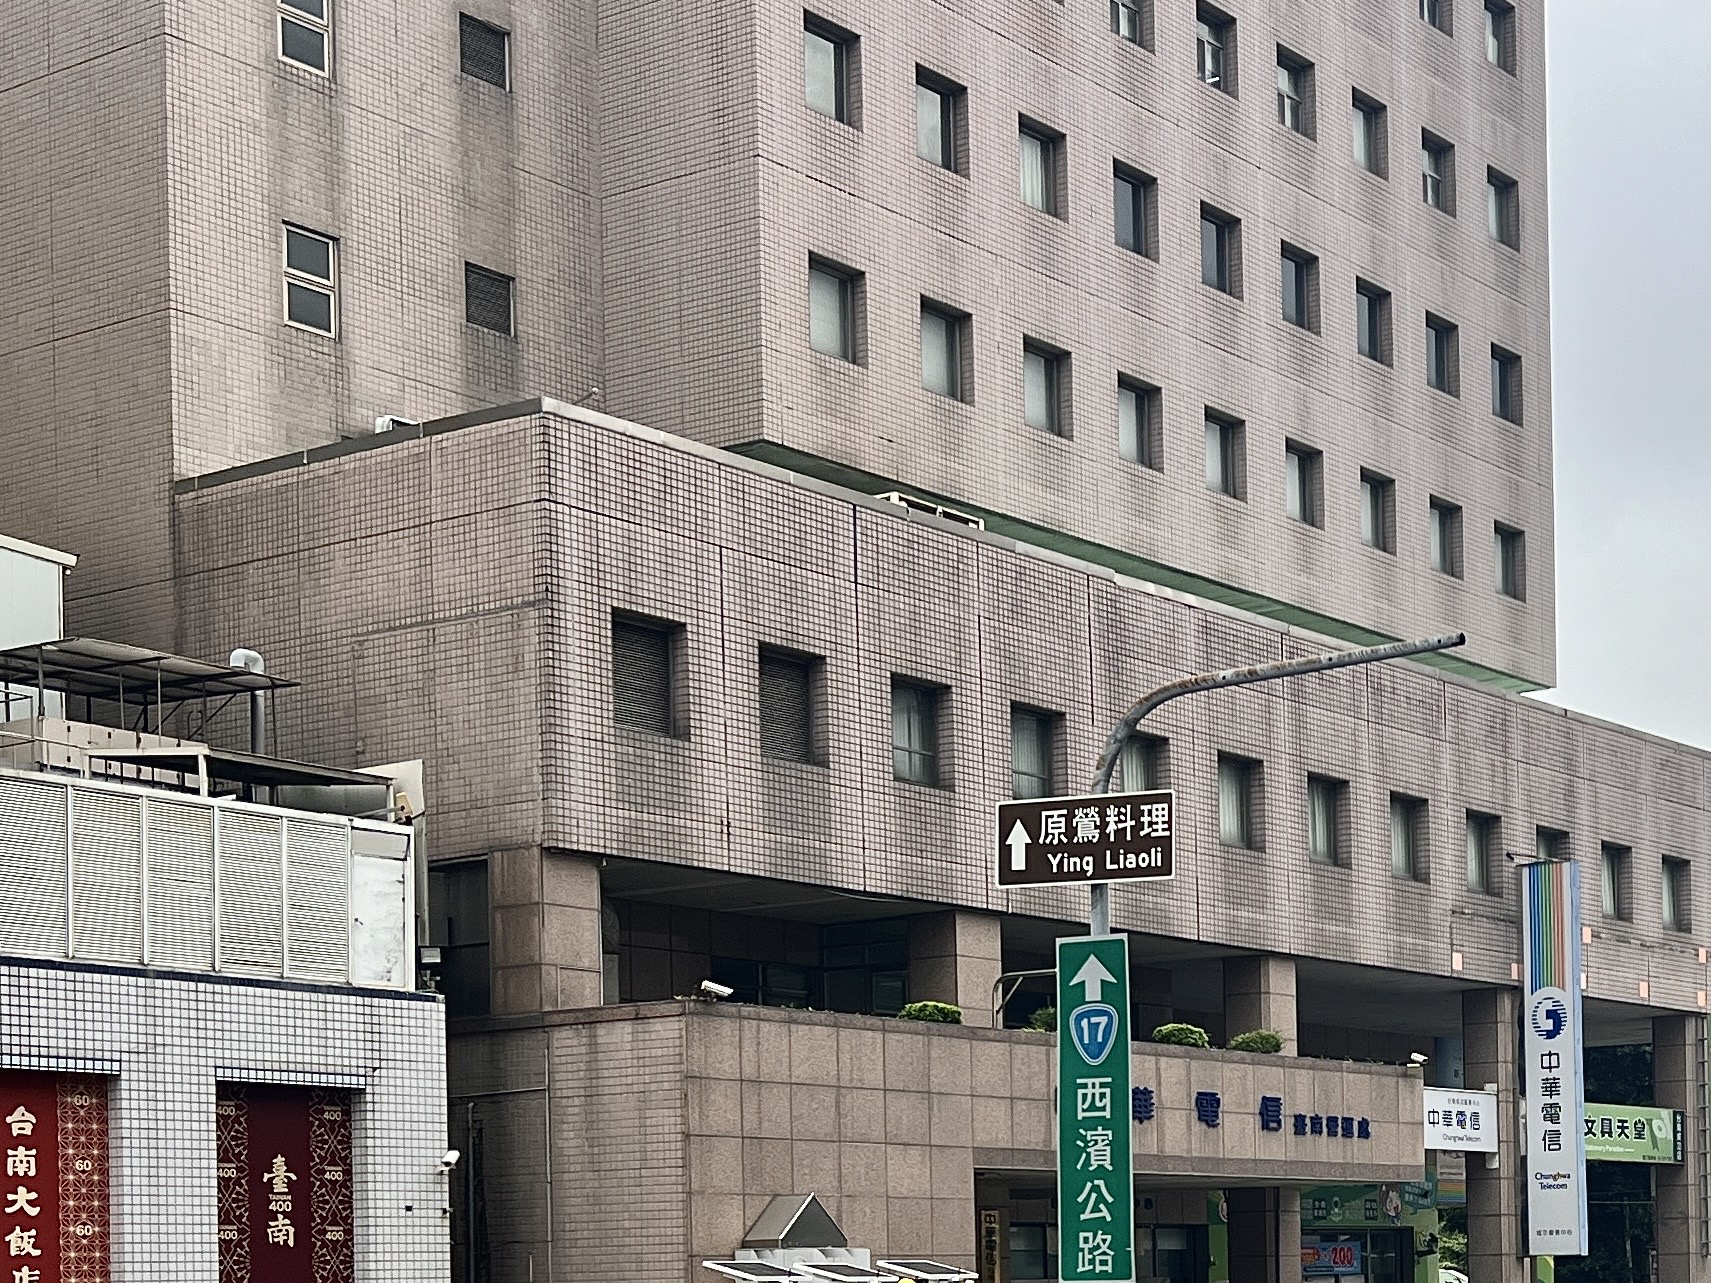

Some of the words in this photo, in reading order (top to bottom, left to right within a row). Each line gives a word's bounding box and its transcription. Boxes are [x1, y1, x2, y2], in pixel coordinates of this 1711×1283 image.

[1039, 803, 1170, 845] 原鶯料理
[1047, 853, 1094, 877] Ying
[1106, 847, 1162, 870] Liaoli
[1080, 1016, 1108, 1044] 17
[1132, 1086, 1283, 1131] 華電信
[1539, 1050, 1562, 1152] 中華電信
[323, 1110, 342, 1120] 400
[1427, 1108, 1481, 1131] 中華電信
[1584, 1114, 1646, 1140] 文具天堂
[75, 1159, 91, 1172] 60
[263, 1154, 297, 1192] 臺
[324, 1171, 343, 1181] 400
[1075, 1076, 1115, 1274] 西濱公路
[1534, 1171, 1571, 1181] Chunghwa
[1538, 1182, 1568, 1190] Telecom
[268, 1201, 292, 1212] 400
[76, 1223, 92, 1236] 60
[266, 1213, 295, 1248] 南
[325, 1231, 344, 1241] 400
